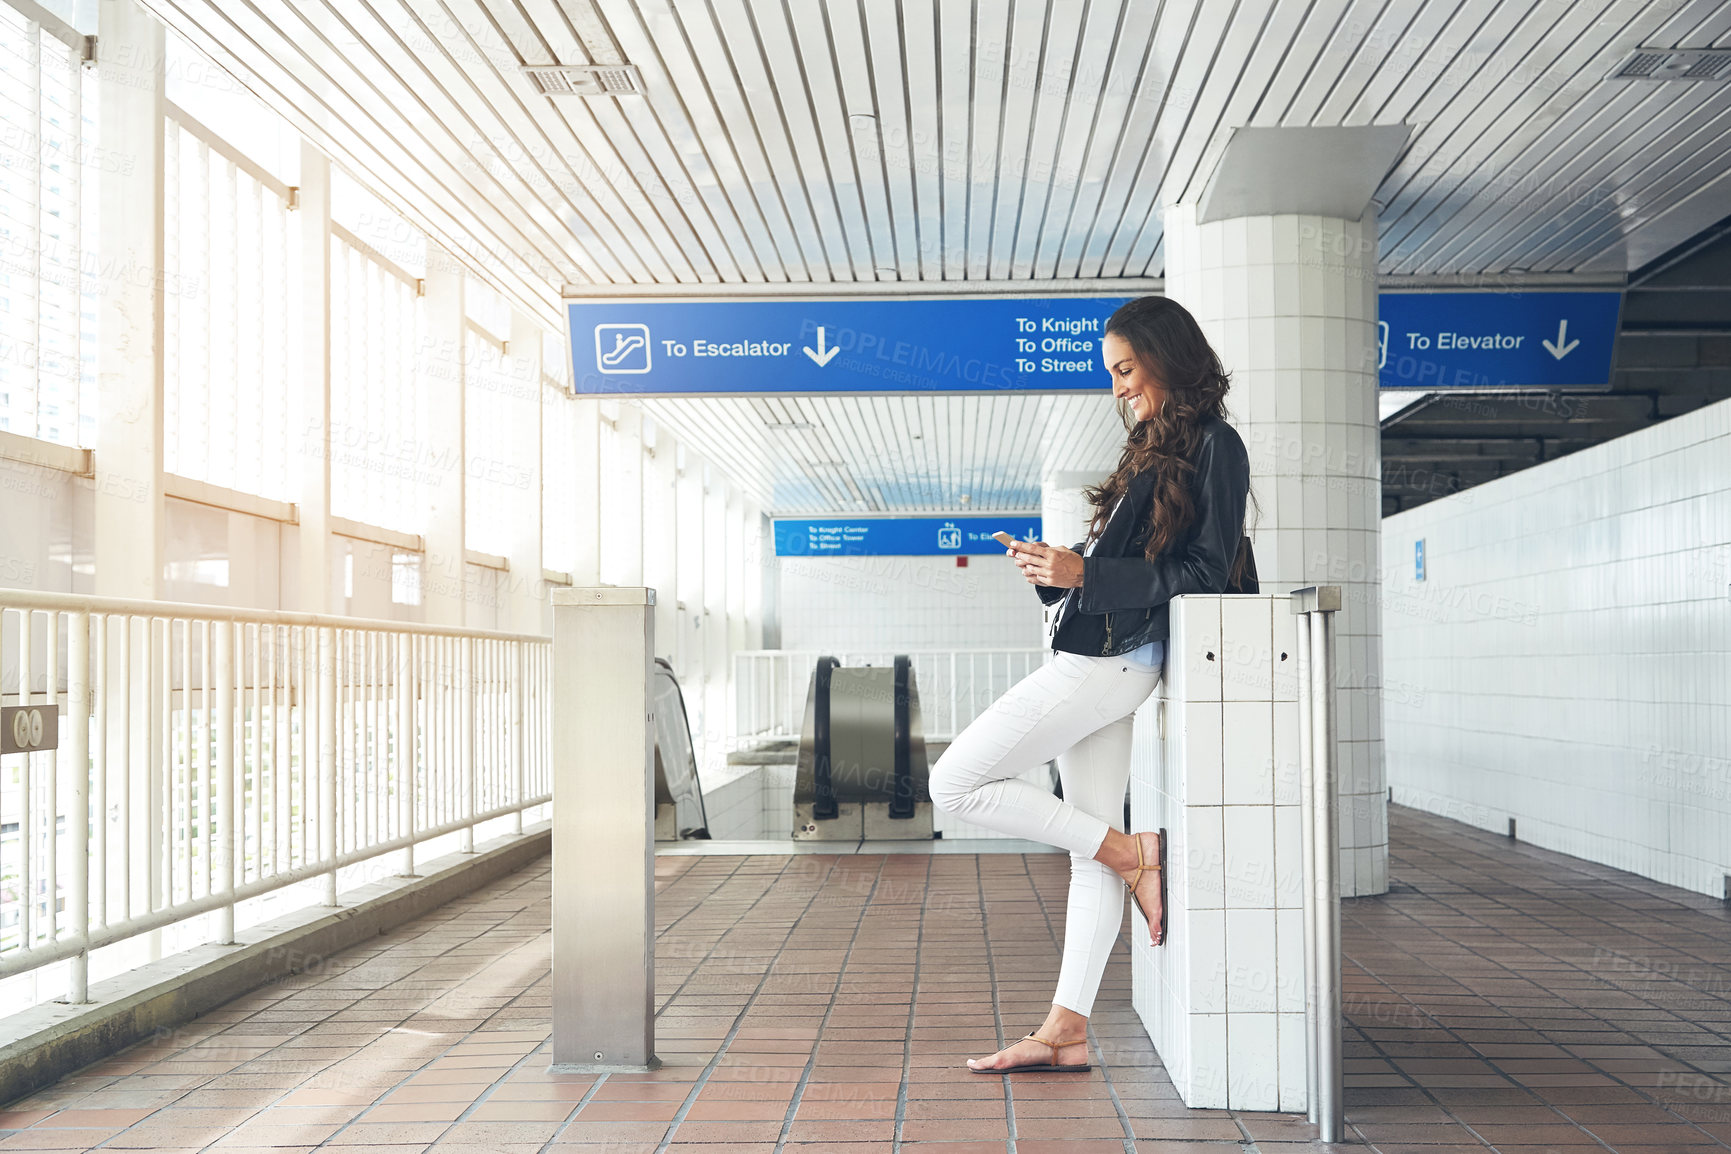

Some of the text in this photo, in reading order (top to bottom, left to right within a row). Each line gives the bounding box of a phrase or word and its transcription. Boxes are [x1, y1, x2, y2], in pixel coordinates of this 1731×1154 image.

[1016, 318, 1036, 332] To
[1042, 317, 1098, 336] Knight
[661, 339, 791, 357] To Escalator
[1016, 338, 1036, 352] To
[1041, 338, 1093, 352] Office
[1406, 332, 1524, 349] To Elevator
[1016, 358, 1093, 372] To Street
[968, 532, 979, 541] To
